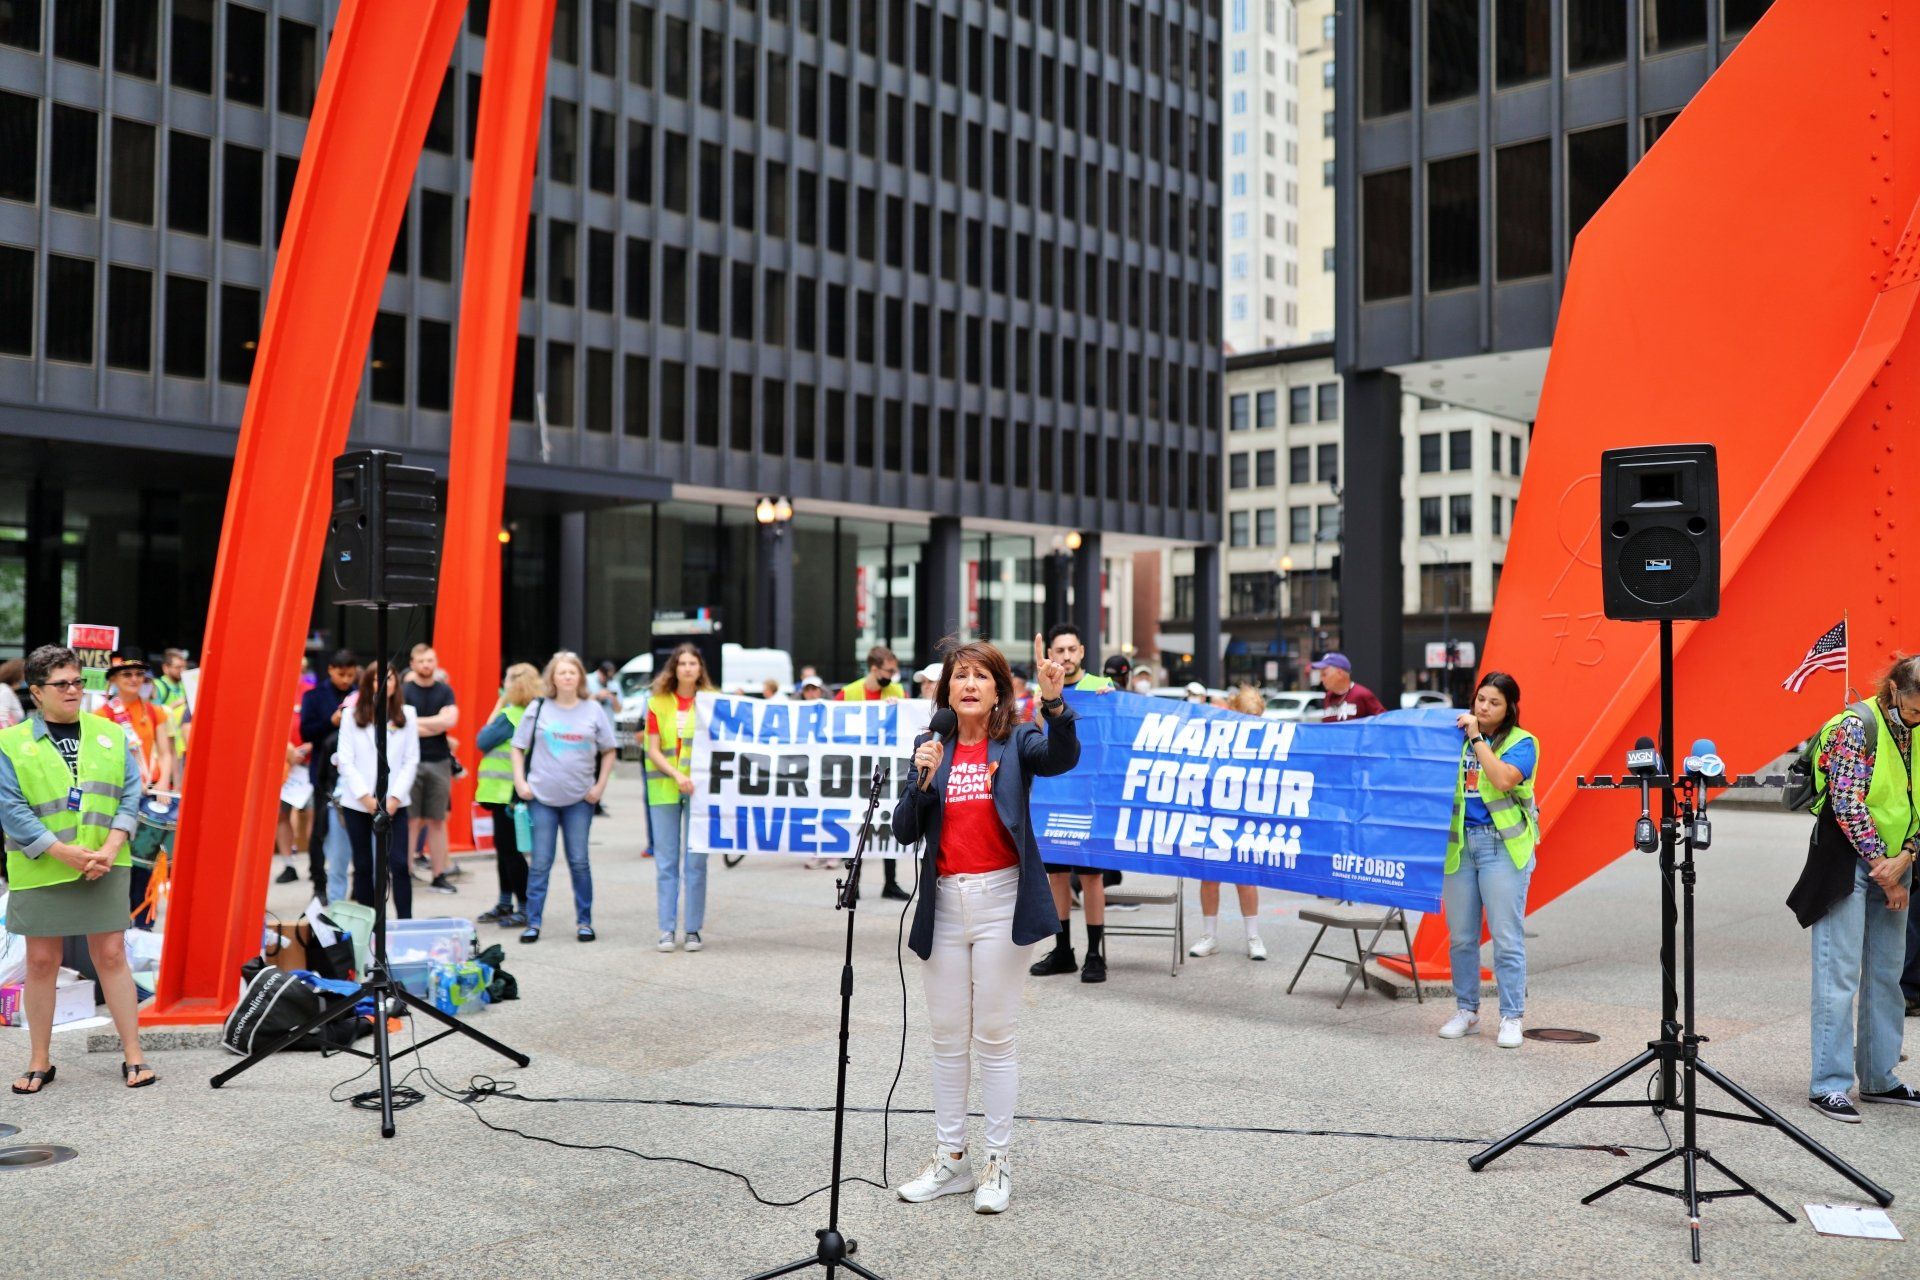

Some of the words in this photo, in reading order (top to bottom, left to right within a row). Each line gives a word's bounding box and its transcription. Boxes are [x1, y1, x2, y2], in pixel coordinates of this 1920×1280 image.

[79, 648, 113, 668] IVES
[1542, 612, 1606, 667] 73
[709, 699, 898, 747] MARCH
[1132, 713, 1297, 762] MARCH
[709, 751, 809, 797] FOR
[1628, 751, 1653, 761] WGN
[947, 782, 985, 796] TION
[1122, 758, 1210, 808] FOR
[1210, 765, 1315, 818] OUR
[708, 805, 851, 854] LIVES
[1043, 829, 1091, 840] EVERYTOWN
[1114, 807, 1239, 862] LIVES
[1332, 853, 1406, 880] GIFFORDS
